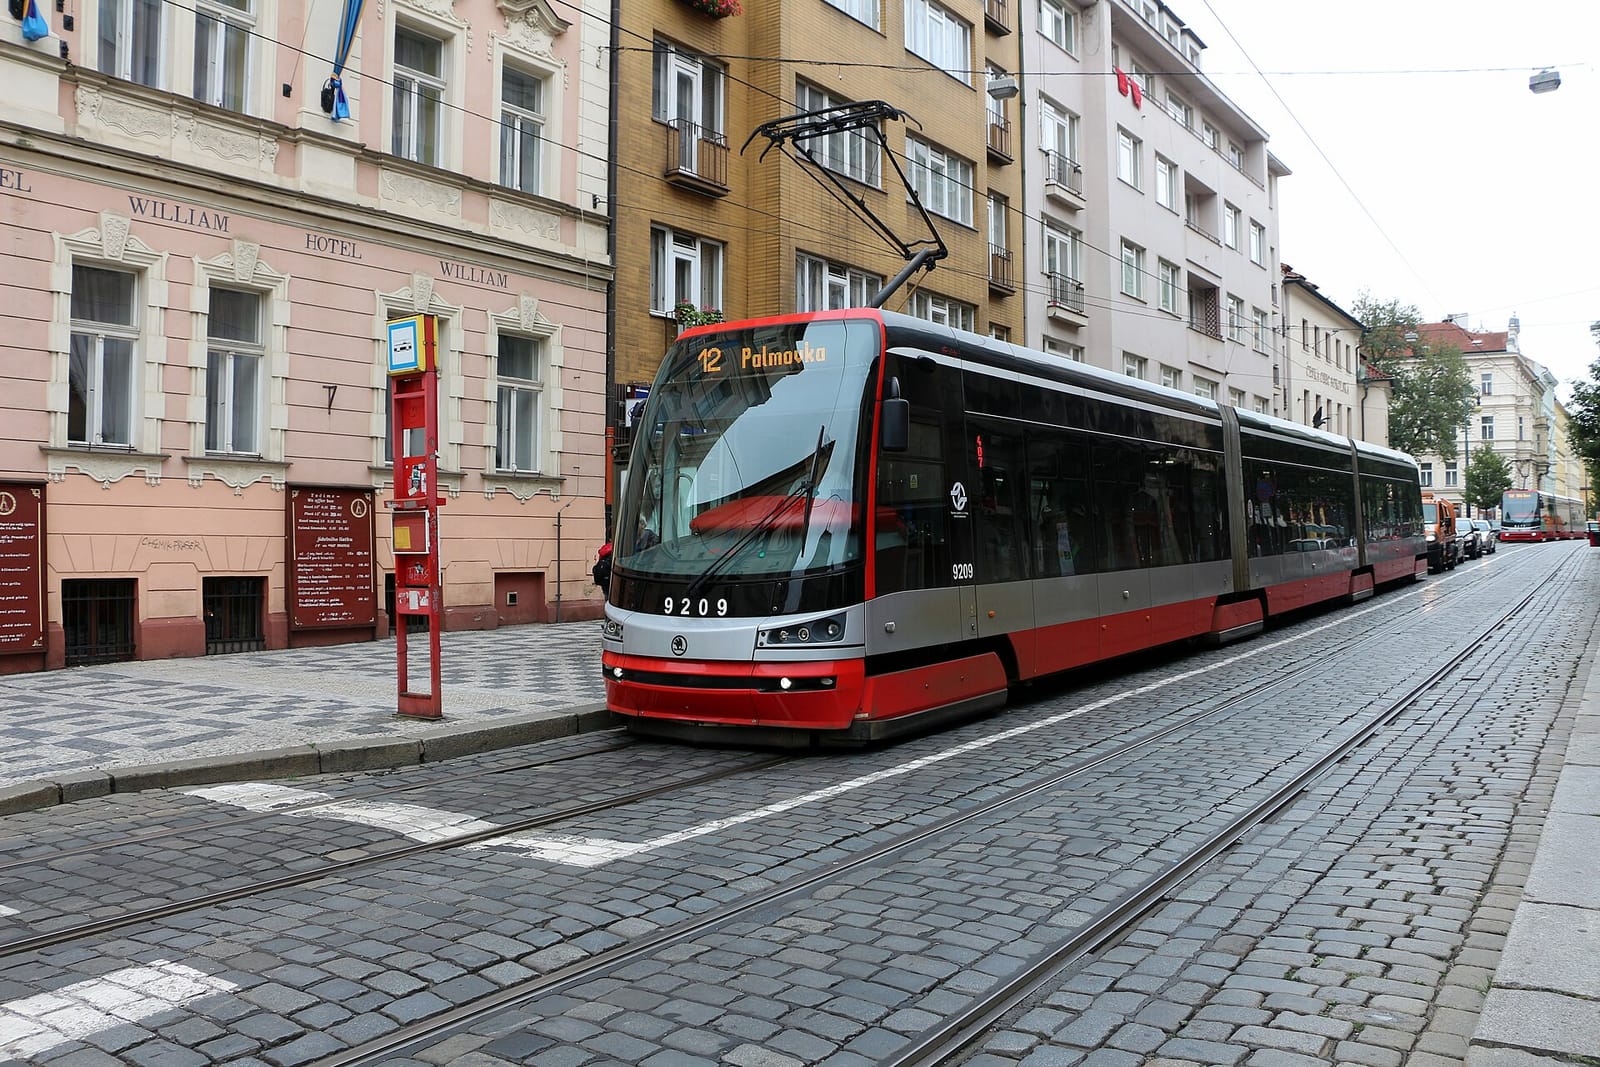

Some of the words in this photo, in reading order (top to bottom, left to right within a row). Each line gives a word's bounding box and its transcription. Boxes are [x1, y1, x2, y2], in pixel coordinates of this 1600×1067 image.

[128, 195, 230, 232] WILLIAM
[305, 233, 362, 259] HOTEL
[439, 261, 508, 288] WILLIAM
[697, 347, 721, 372] 12
[741, 341, 826, 369] Palmovka
[952, 563, 974, 580] 9209
[664, 596, 728, 616] 9209
